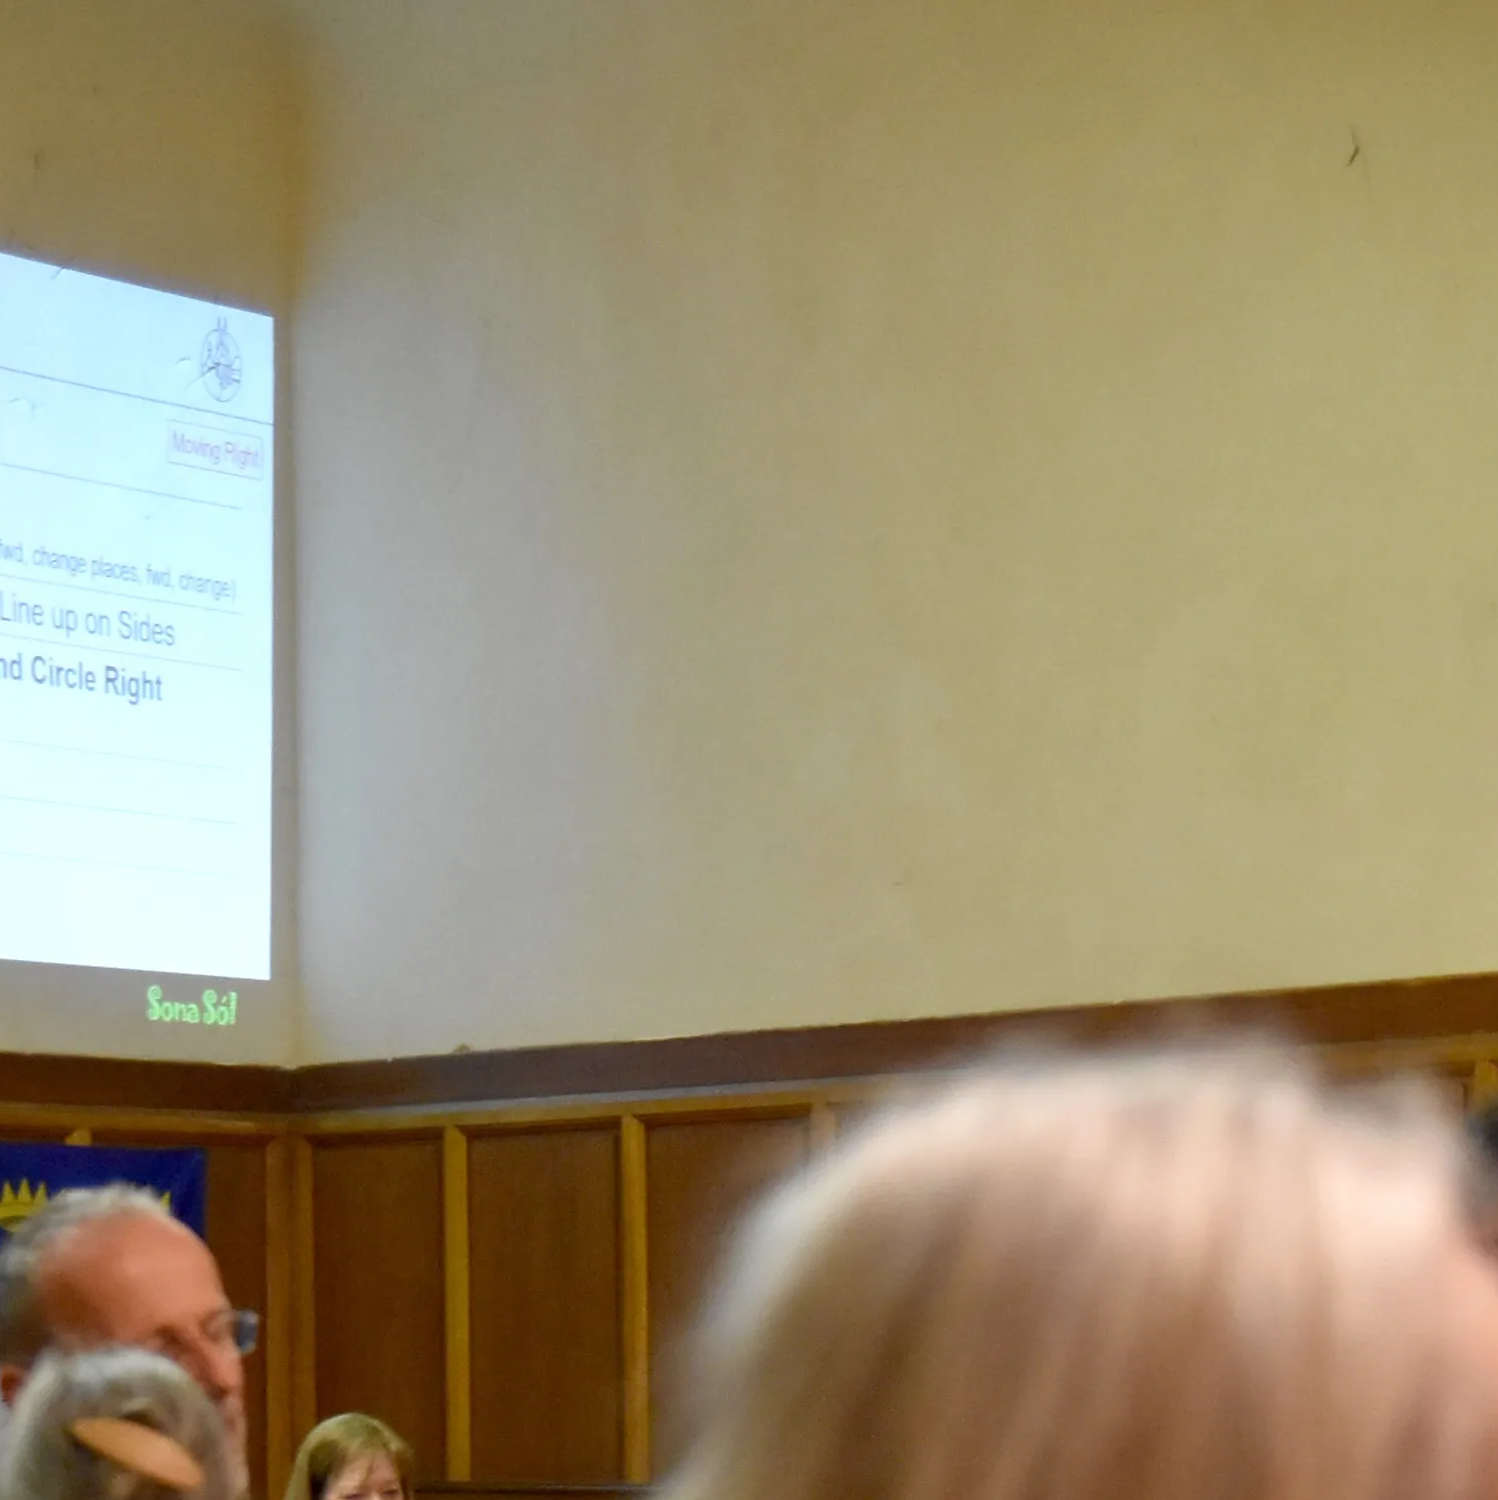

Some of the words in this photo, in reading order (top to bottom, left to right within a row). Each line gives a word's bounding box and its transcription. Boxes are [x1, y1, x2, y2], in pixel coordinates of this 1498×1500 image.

[32, 544, 87, 577] change
[51, 607, 79, 638] up
[84, 611, 111, 637] on
[117, 609, 176, 647] Sides
[30, 653, 98, 692] Circle
[103, 664, 164, 706] Right
[146, 983, 200, 1024] Sona
